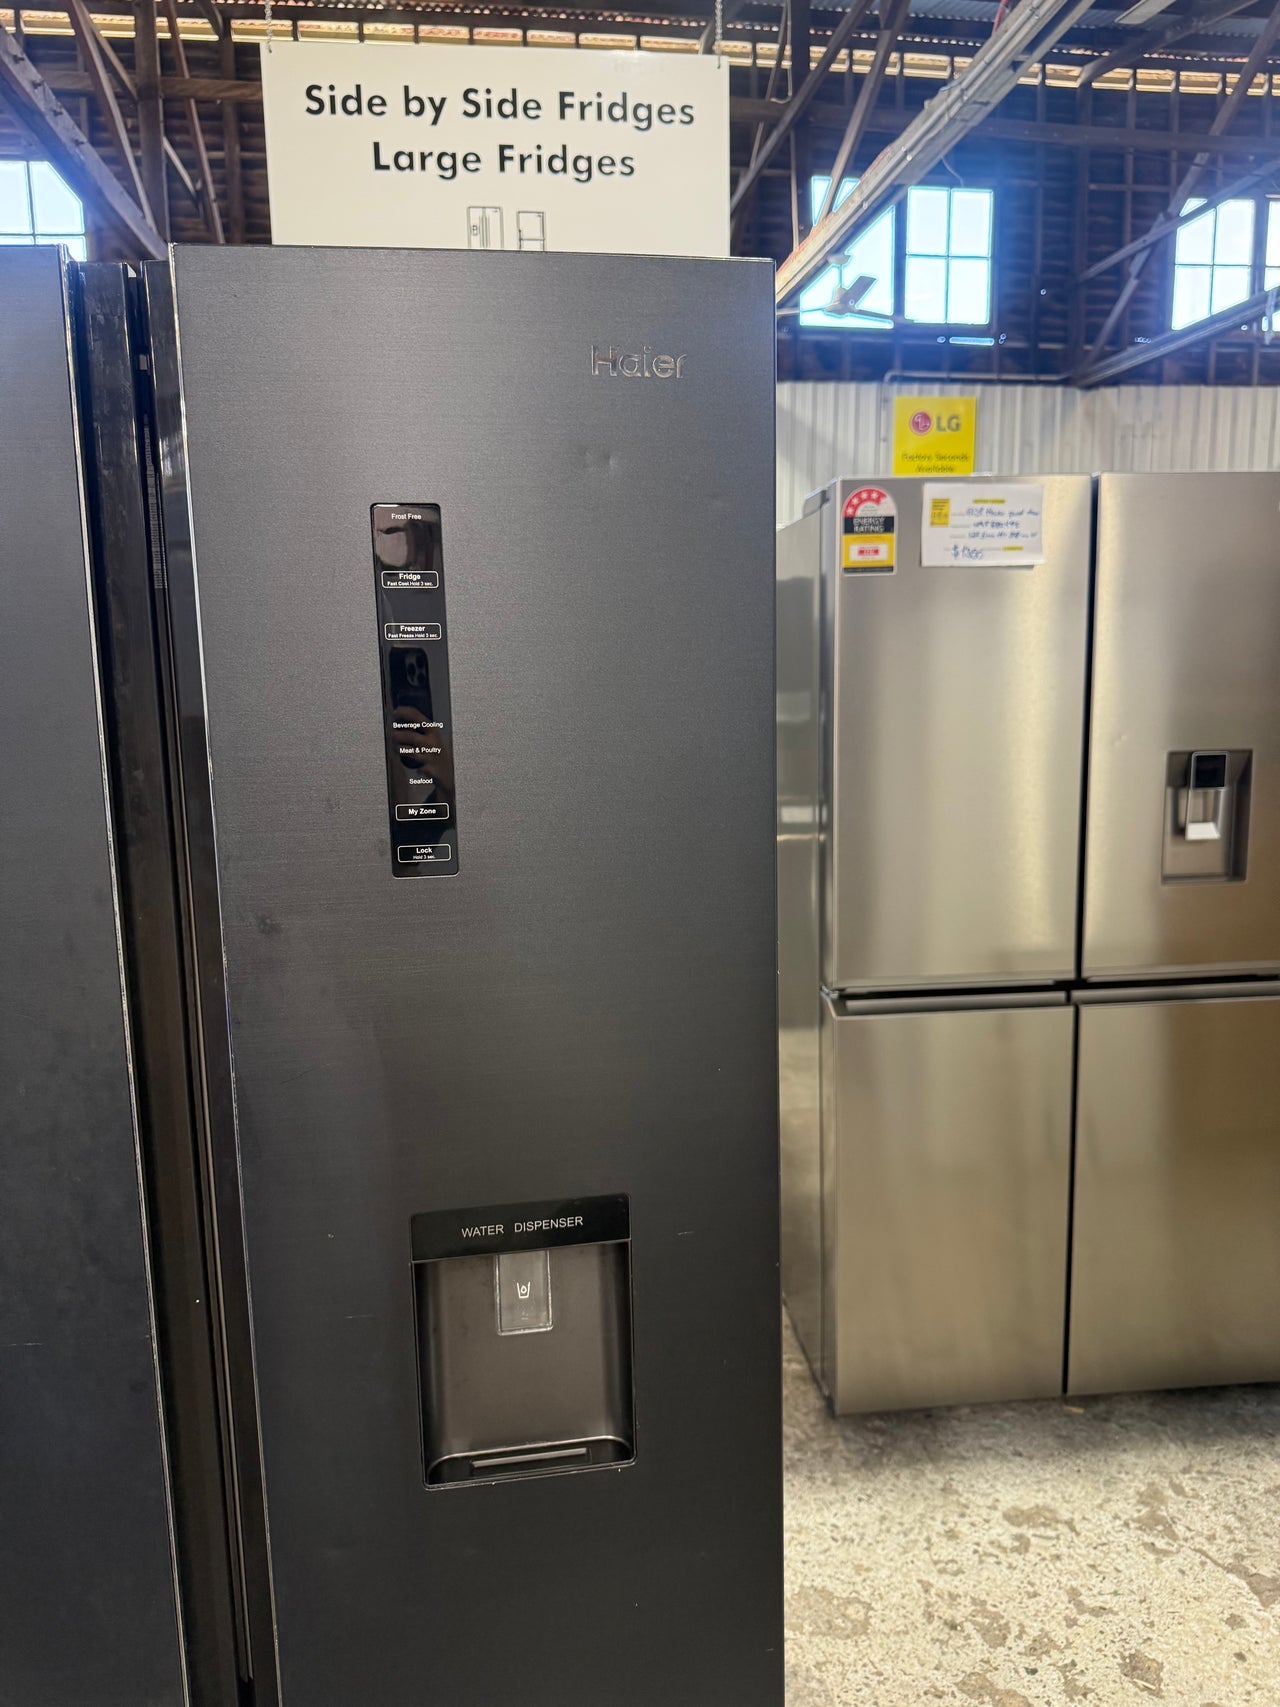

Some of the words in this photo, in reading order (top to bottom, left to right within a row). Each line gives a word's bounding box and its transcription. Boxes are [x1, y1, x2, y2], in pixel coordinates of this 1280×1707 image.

[305, 84, 388, 117] Side
[403, 85, 447, 126] by
[462, 87, 543, 121] Side
[558, 90, 696, 132] Fridges
[373, 141, 482, 181] Large
[499, 144, 637, 184] Fridges
[590, 344, 688, 379] Haier
[935, 414, 962, 433] LG
[398, 573, 421, 581] Fridge
[421, 721, 444, 729] Cooling
[408, 808, 419, 816] My
[461, 1224, 505, 1239] WATER
[514, 1216, 584, 1233] DISPENSER
